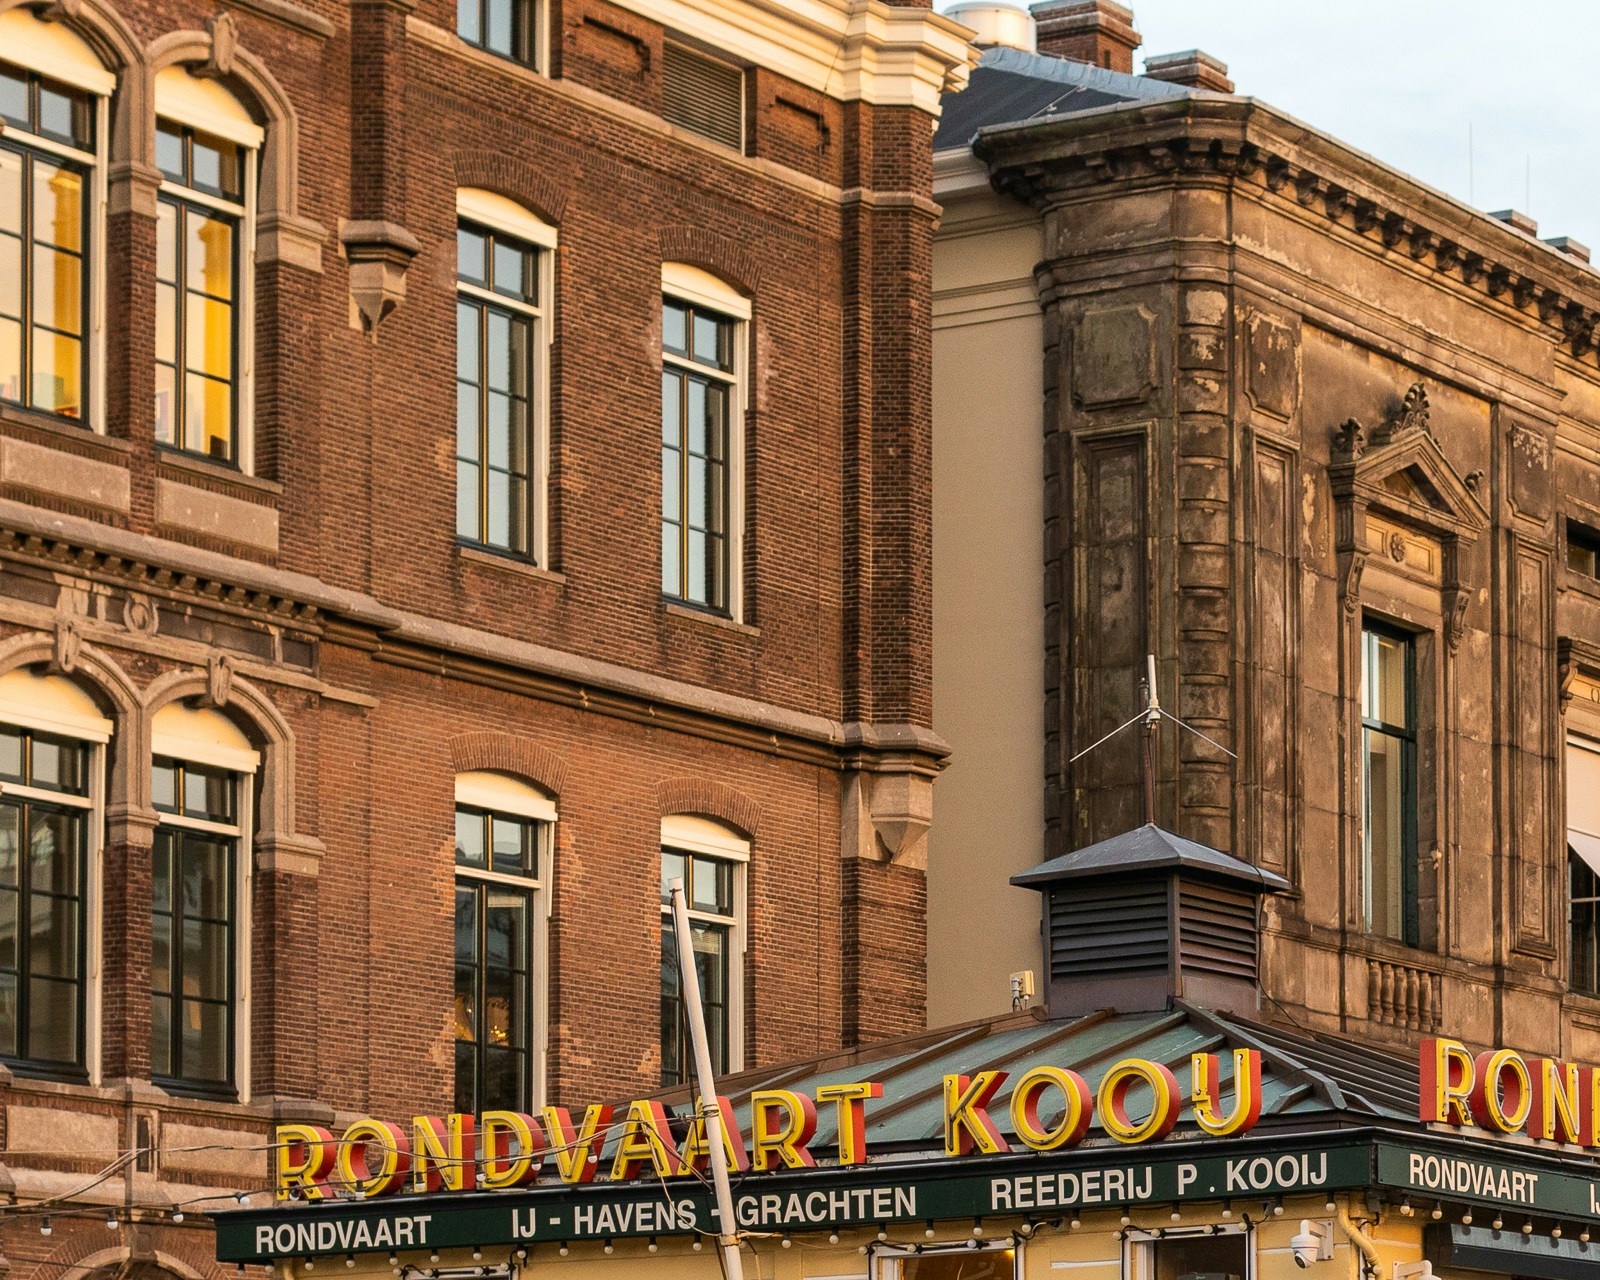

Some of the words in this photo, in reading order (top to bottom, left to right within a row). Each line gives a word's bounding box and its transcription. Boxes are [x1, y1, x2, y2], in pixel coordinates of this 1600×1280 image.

[275, 1082, 883, 1201] RONDVAART
[1409, 1153, 1539, 1204] RONDVAART
[255, 1215, 432, 1254] RONDVAART
[511, 1207, 537, 1238] IJ
[573, 1199, 697, 1235] HAVENS
[738, 1186, 917, 1226] GRACHTEN
[991, 1166, 1152, 1210] REEDERIJ
[1226, 1152, 1328, 1192] KOOIJ
